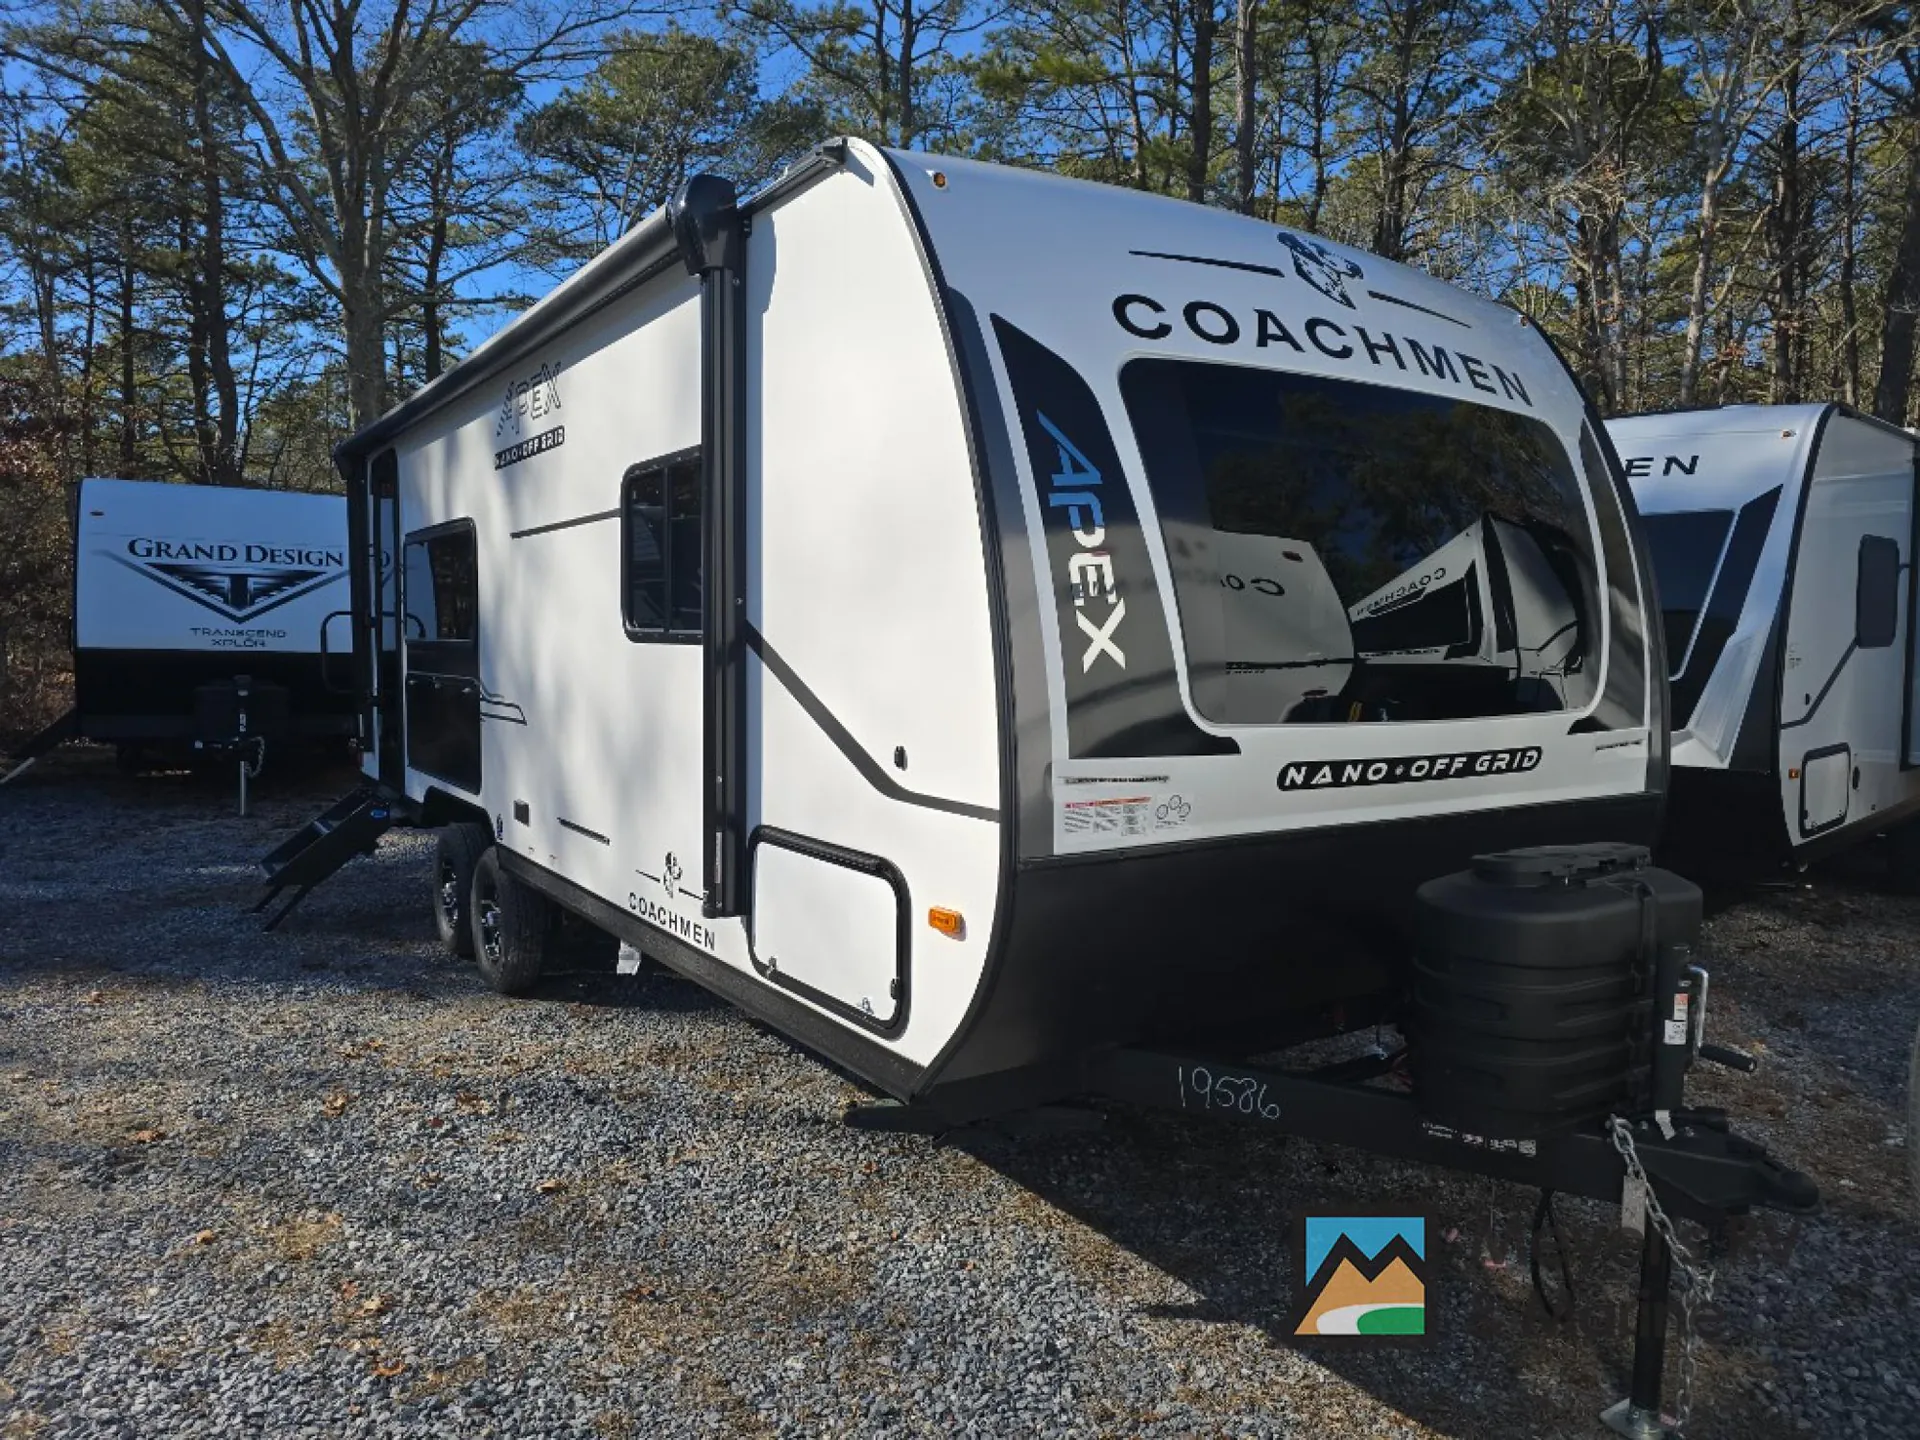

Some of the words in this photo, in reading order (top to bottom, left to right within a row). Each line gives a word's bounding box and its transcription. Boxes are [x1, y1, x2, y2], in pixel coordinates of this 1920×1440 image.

[1111, 293, 1533, 408] COACHMEN
[127, 537, 238, 562] GRAND
[245, 544, 343, 567] DESIGN
[1036, 408, 1126, 674] APEX
[189, 627, 287, 638] TRANSCEND
[1283, 762, 1388, 787] NANO
[1410, 757, 1467, 777] OFF
[1474, 749, 1541, 773] GRID
[628, 892, 716, 951] COACHMEN
[1178, 1065, 1281, 1119] 19586
